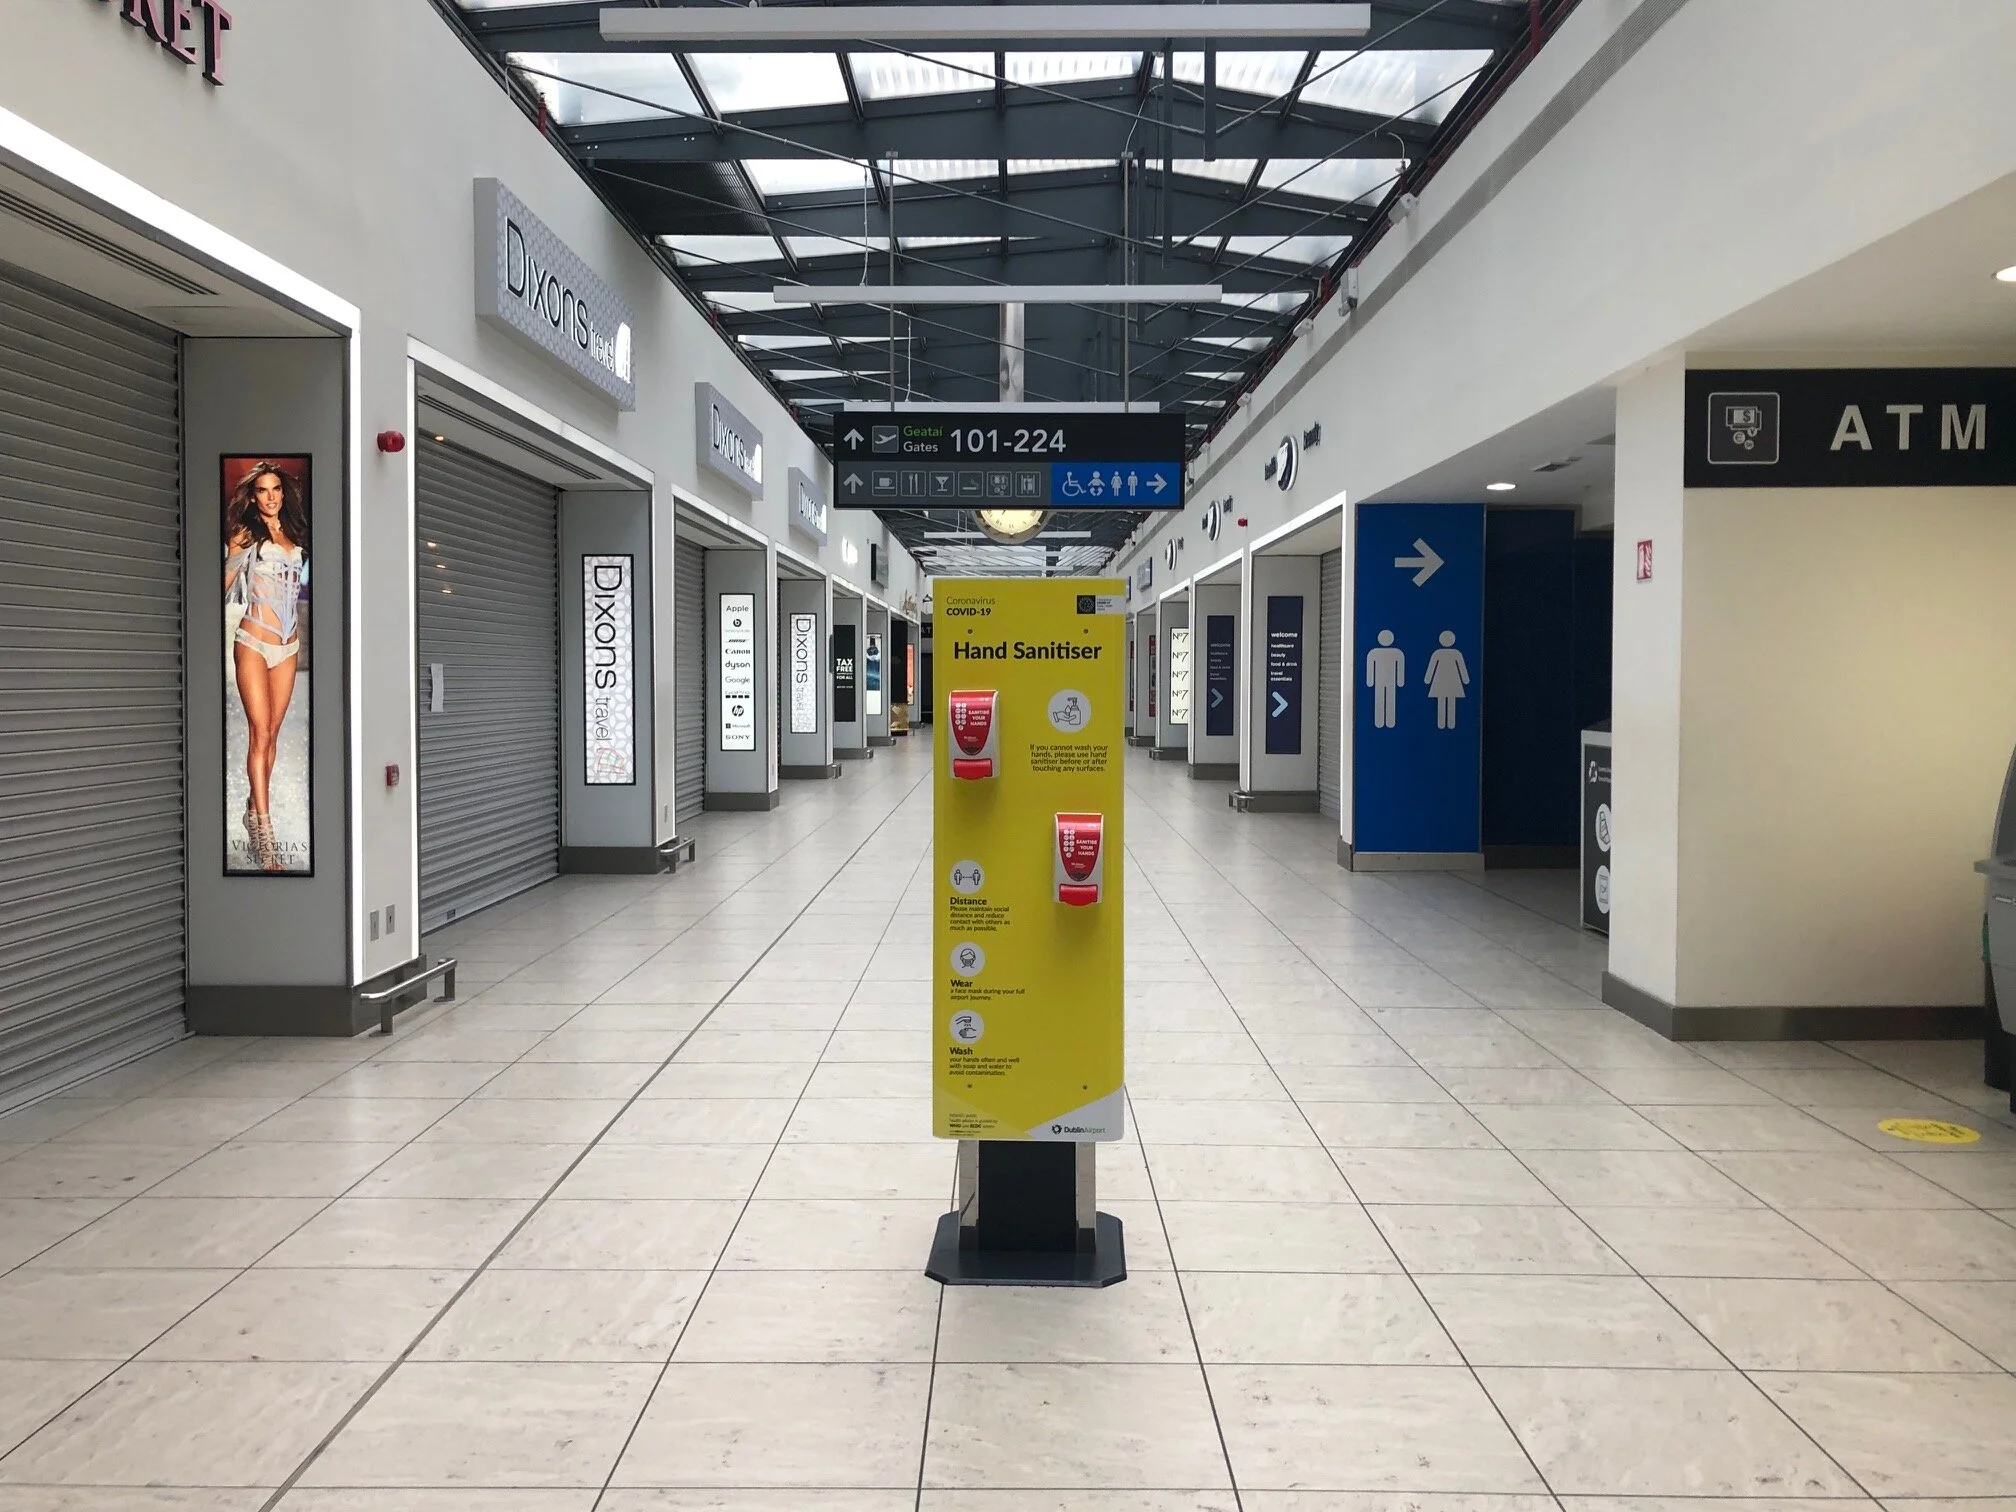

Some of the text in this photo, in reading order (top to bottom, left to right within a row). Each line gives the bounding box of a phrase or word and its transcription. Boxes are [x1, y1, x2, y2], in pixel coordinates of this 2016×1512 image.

[505, 216, 589, 350] Dixons
[903, 425, 943, 437] Geataí
[1830, 404, 1987, 451] ATM
[711, 403, 744, 471] Dixons
[950, 428, 1067, 453] 101-224
[903, 441, 939, 453] Gates
[946, 596, 996, 605] Coronavirus
[946, 607, 992, 616] COVID-19
[594, 565, 623, 741] Dixons travel
[796, 618, 811, 683] Dixons
[954, 641, 1102, 659] Hand Sanitiser
[725, 660, 750, 670] dyson
[836, 658, 853, 666] TAX
[725, 676, 750, 685] Google
[950, 897, 987, 905] Distance
[949, 1047, 973, 1055] Wash
